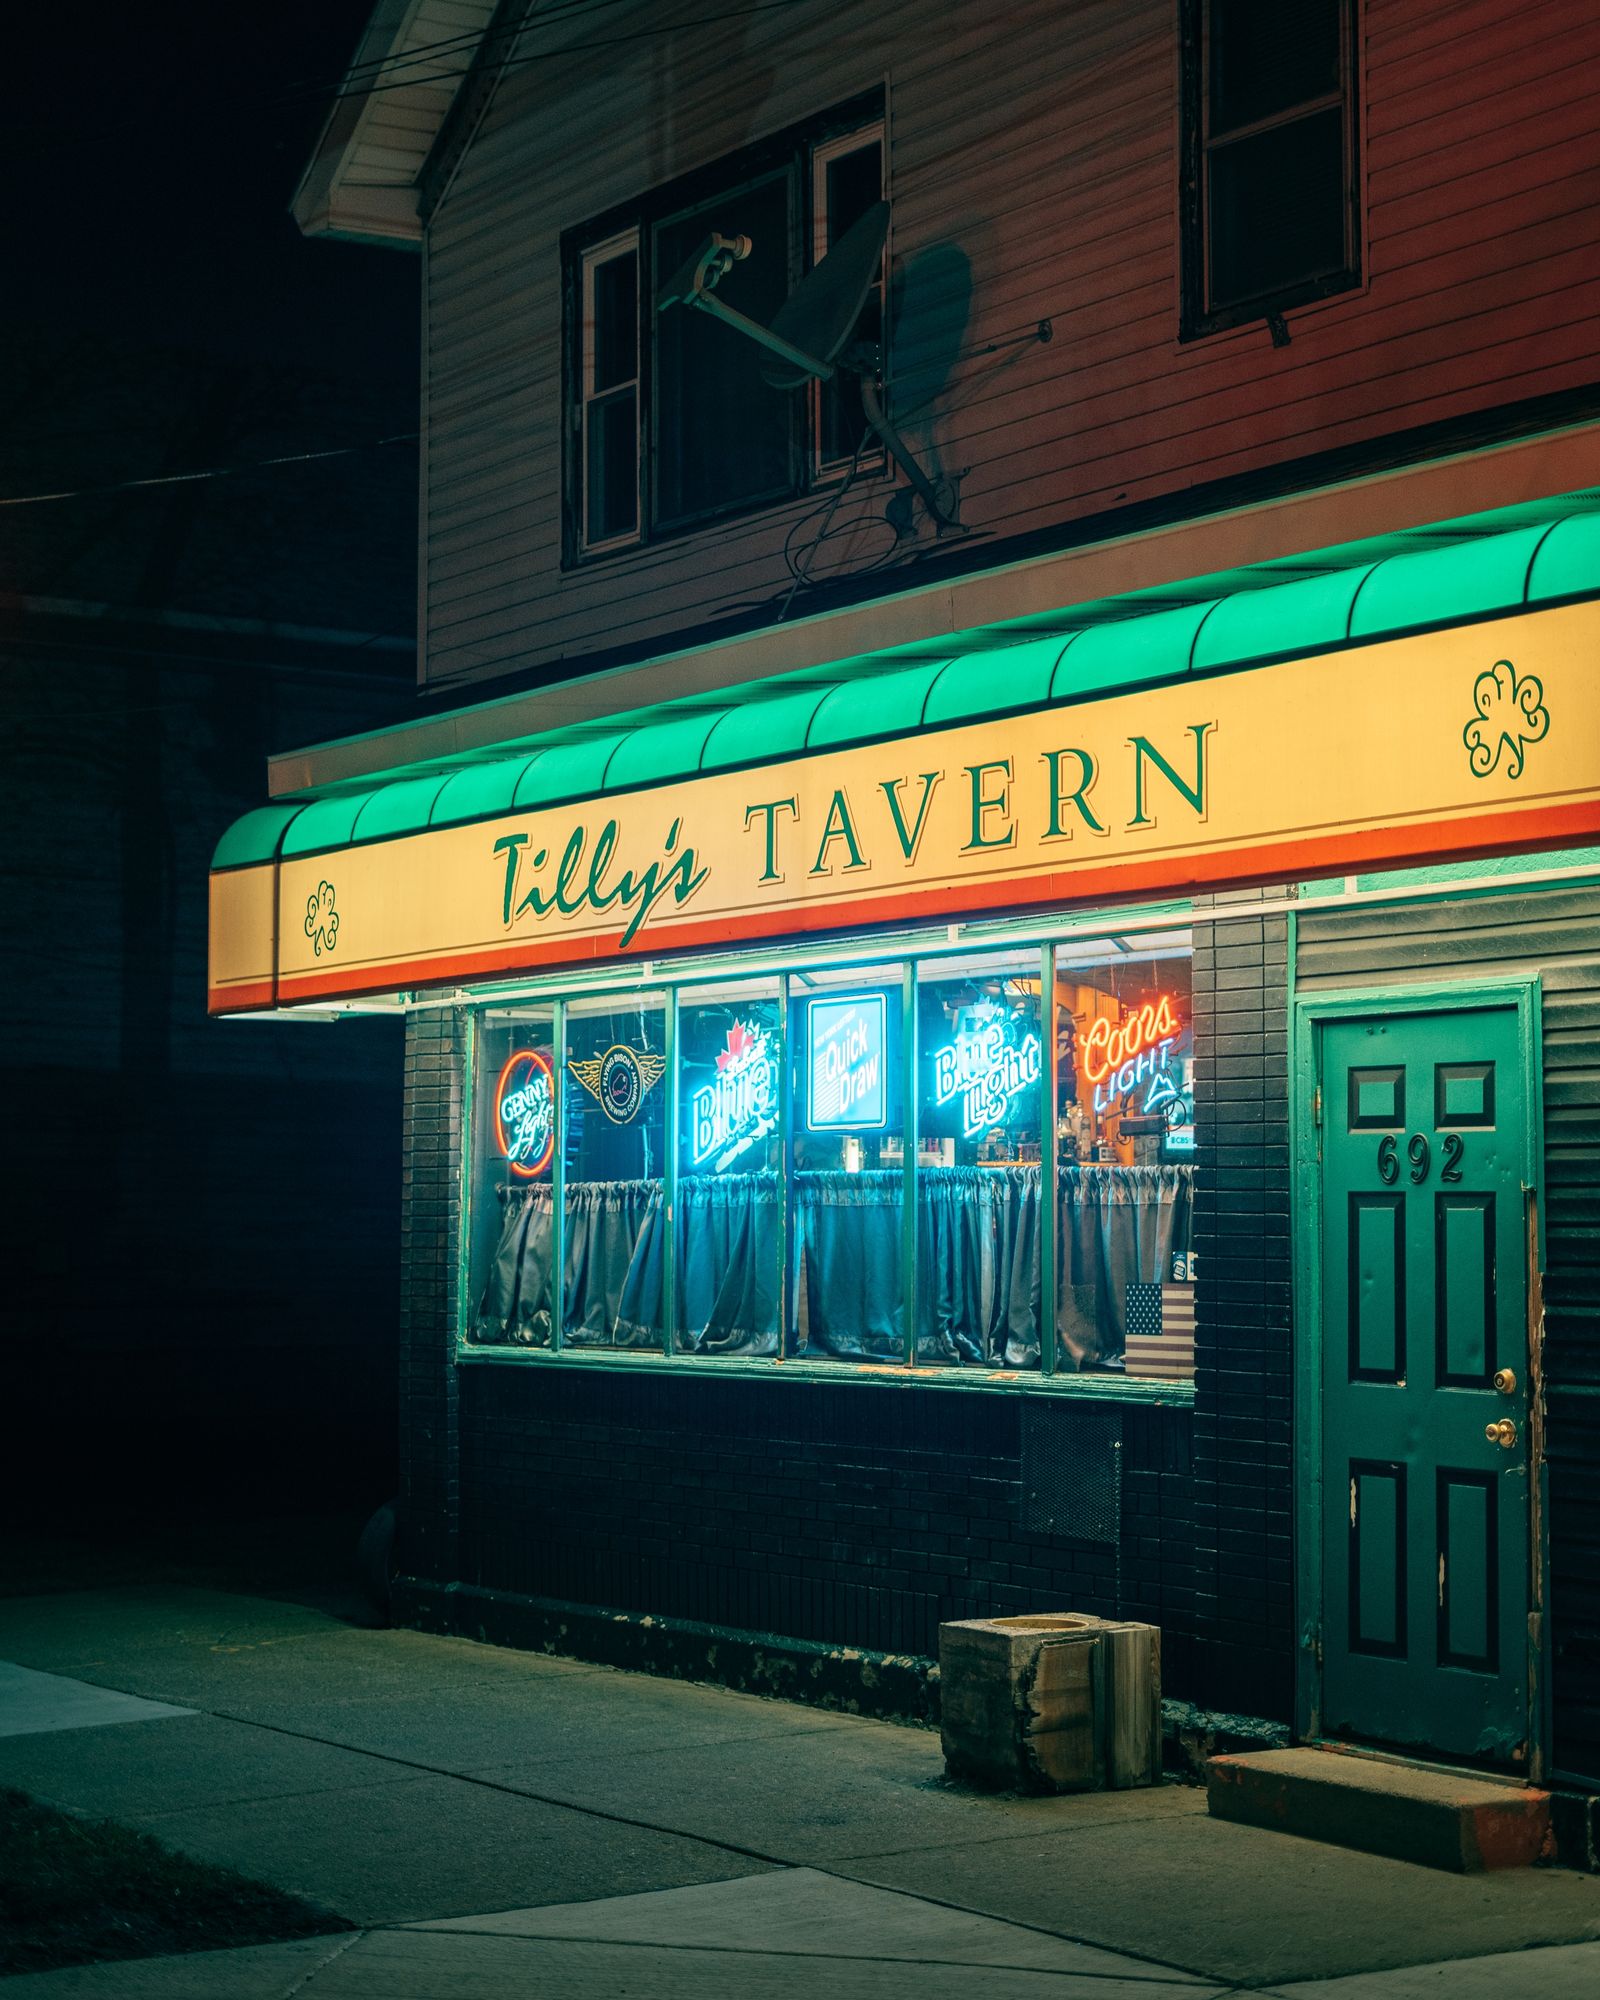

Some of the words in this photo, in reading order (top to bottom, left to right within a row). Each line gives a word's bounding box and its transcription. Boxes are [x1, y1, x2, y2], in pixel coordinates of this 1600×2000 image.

[493, 817, 711, 949] Tilly's
[745, 719, 1217, 888] TAVERN
[602, 1056, 615, 1087] FLYING
[613, 1053, 633, 1069] BISON
[825, 1016, 868, 1081] Quick
[934, 1023, 1004, 1106] Blue
[1080, 995, 1177, 1083] Coors
[500, 1072, 549, 1123] GENNY
[604, 1094, 628, 1117] BREWING
[626, 1071, 638, 1113] COMPANY
[839, 1052, 880, 1115] Draw
[963, 1033, 1040, 1138] Light
[1093, 1037, 1174, 1113] LIGHT
[693, 1057, 771, 1166] Blue
[1377, 1133, 1464, 1185] 692
